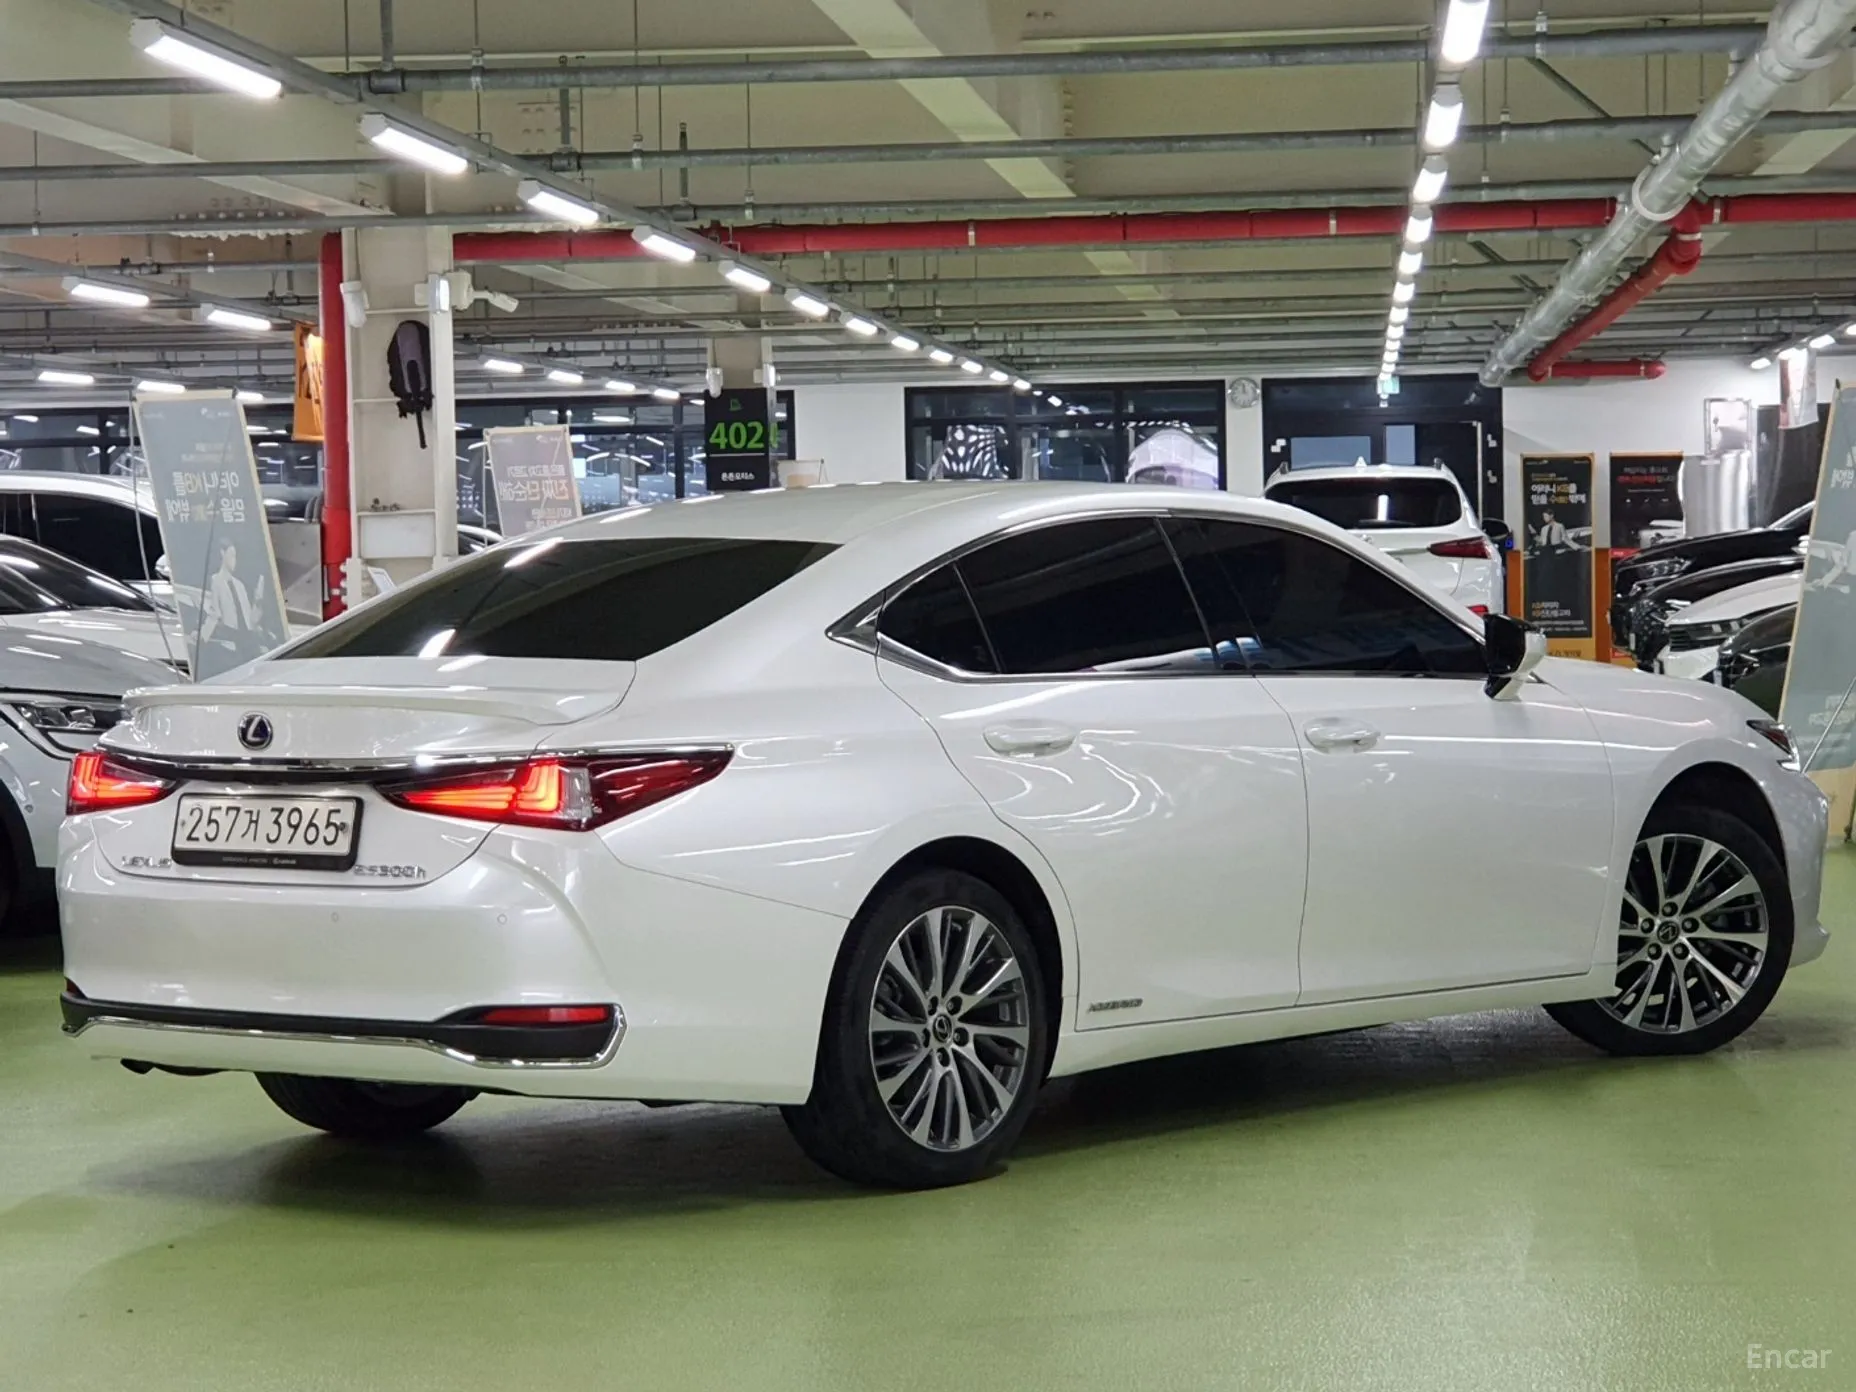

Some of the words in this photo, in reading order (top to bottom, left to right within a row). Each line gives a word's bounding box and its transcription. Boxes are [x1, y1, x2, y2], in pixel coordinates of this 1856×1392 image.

[708, 421, 765, 450] 402
[186, 805, 261, 843] 257거
[265, 806, 342, 846] 3965
